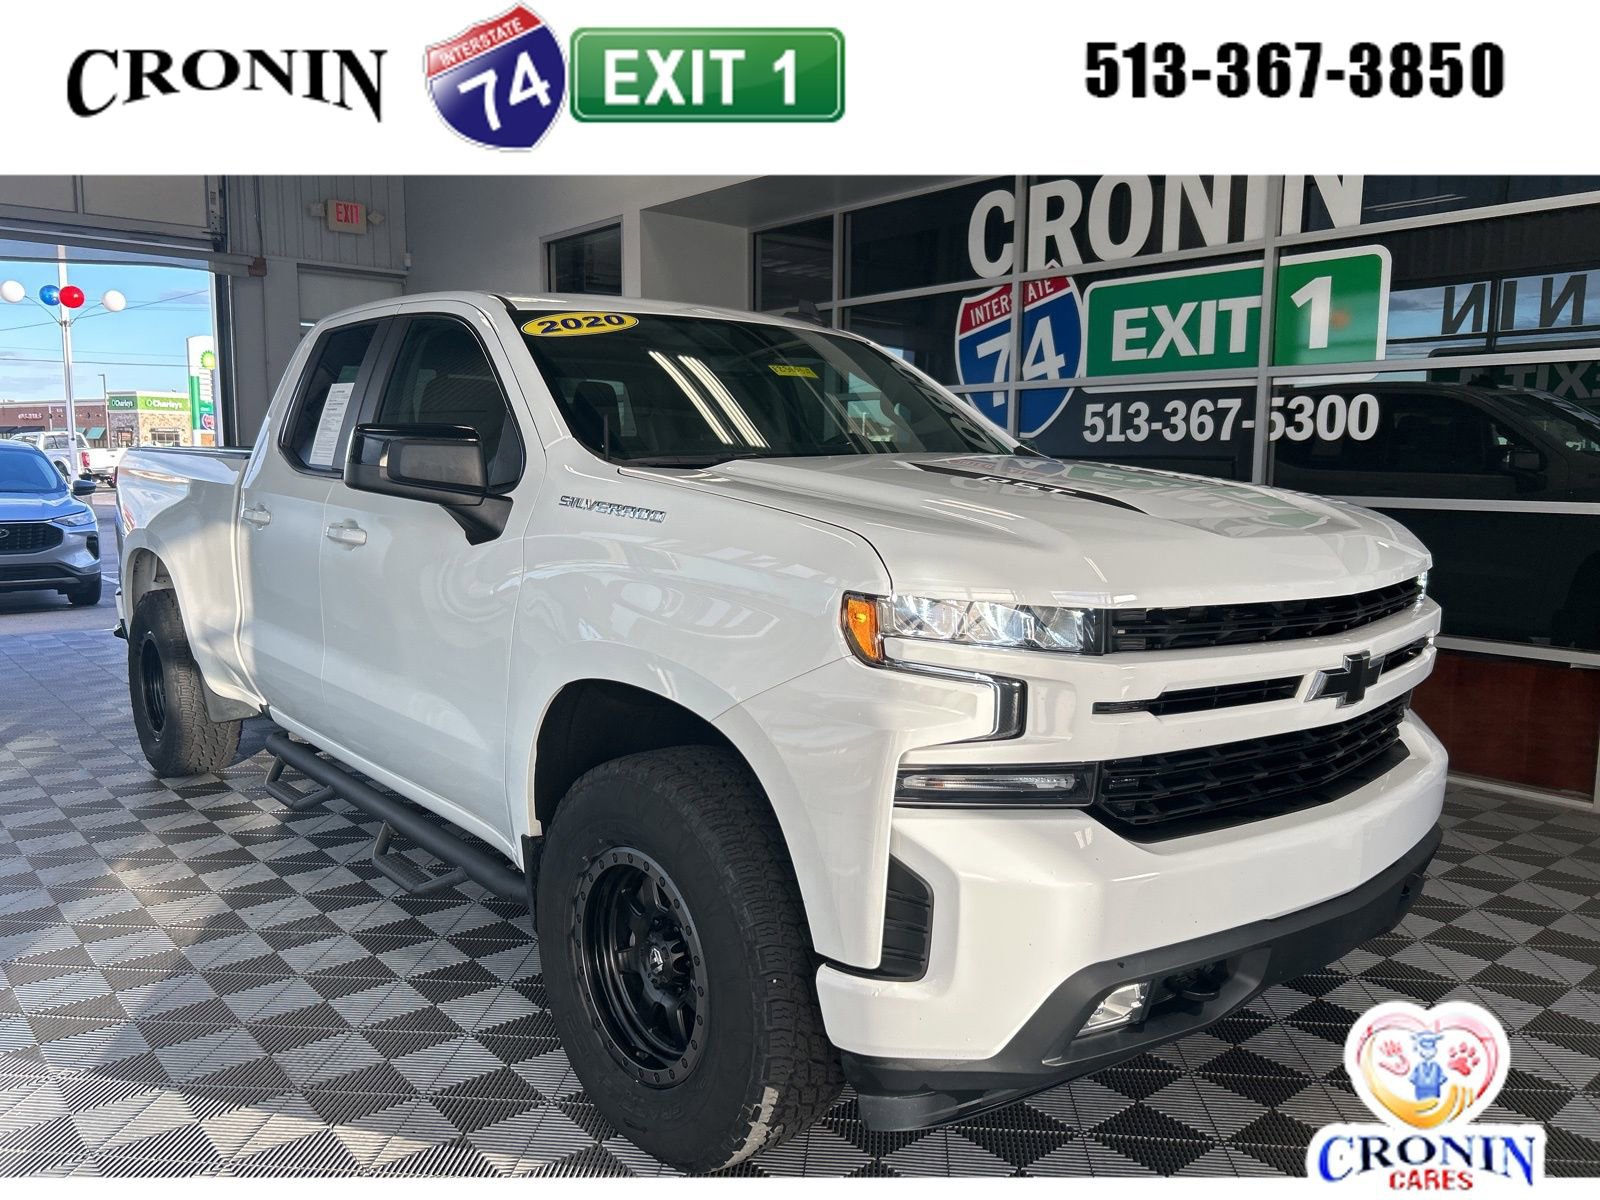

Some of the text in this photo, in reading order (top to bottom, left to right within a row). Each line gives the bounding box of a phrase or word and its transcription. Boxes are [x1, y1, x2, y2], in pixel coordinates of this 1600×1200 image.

[336, 202, 359, 225] EXIT
[968, 174, 1365, 279] CRONIN
[537, 314, 626, 334] 2020
[970, 279, 1055, 327] INTERATE
[1111, 275, 1332, 362] EXIT 1
[976, 316, 1066, 408] 74
[1082, 393, 1380, 443] 513-367-5300
[559, 495, 666, 524] SILVERADO
